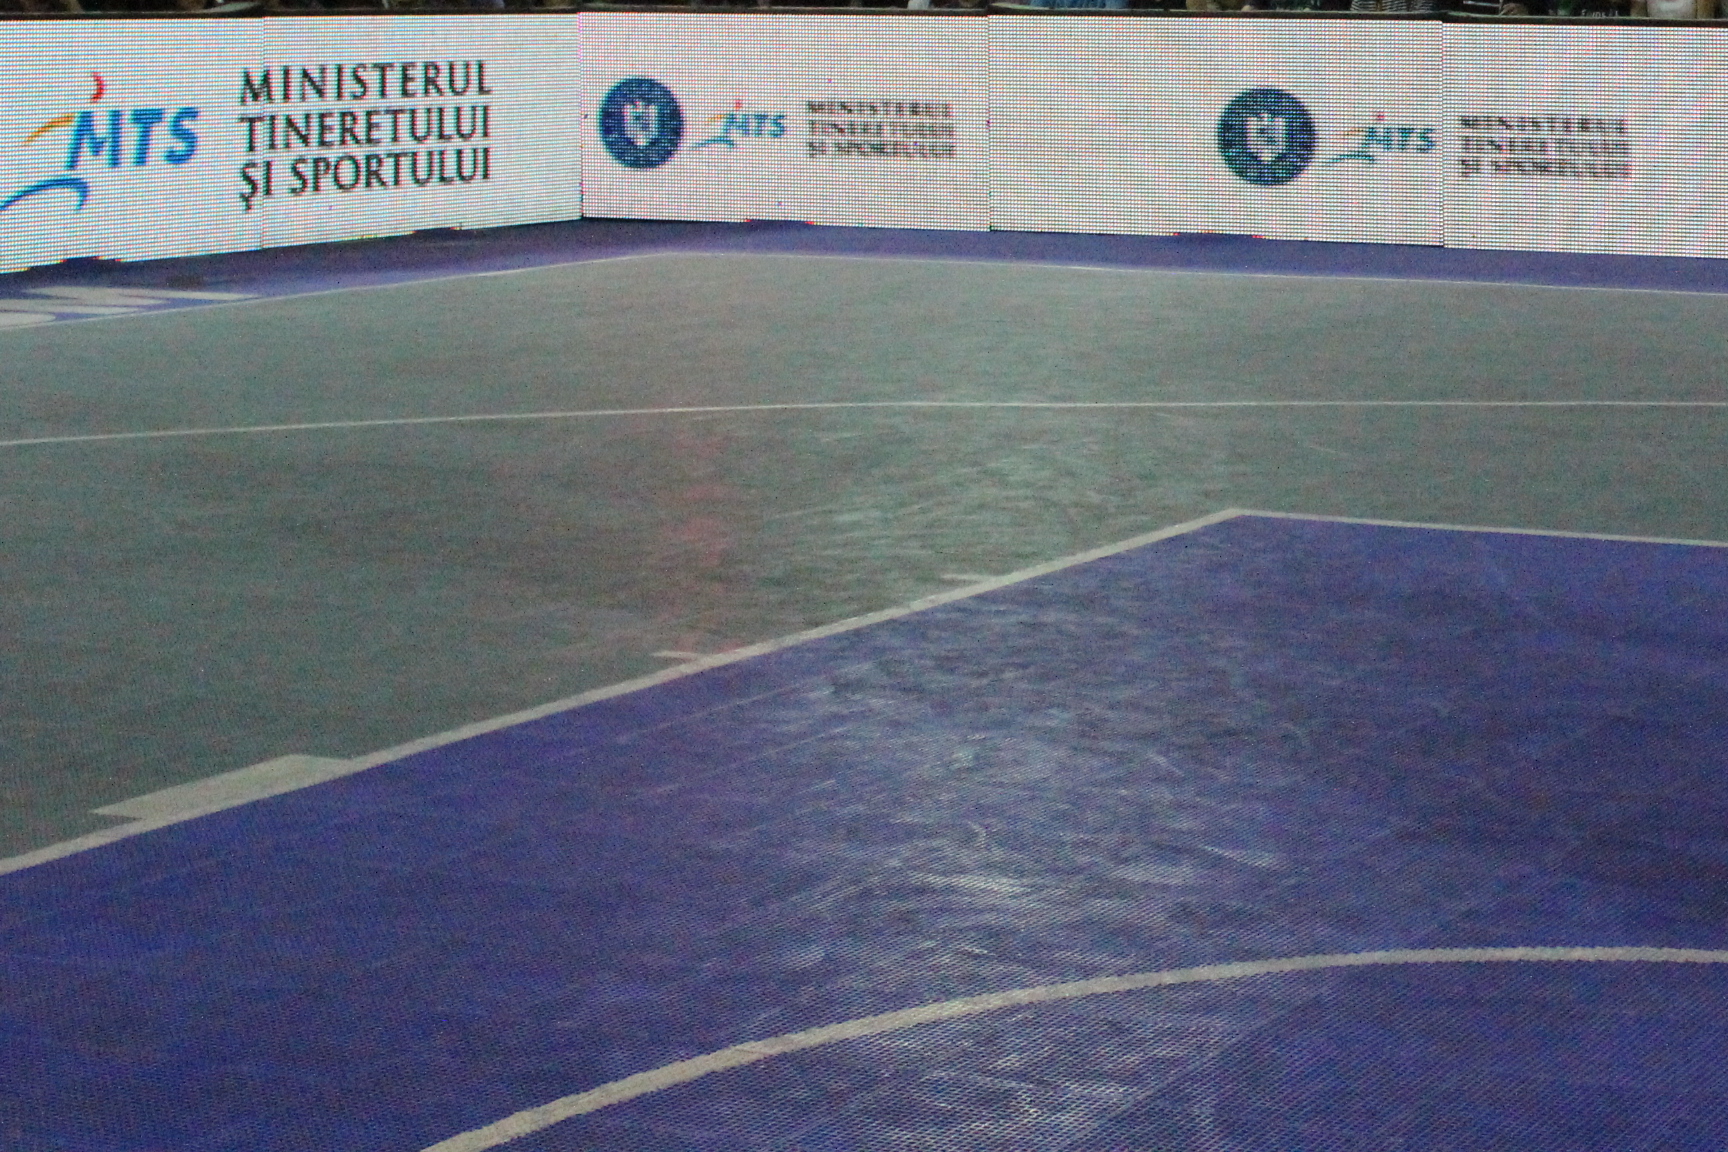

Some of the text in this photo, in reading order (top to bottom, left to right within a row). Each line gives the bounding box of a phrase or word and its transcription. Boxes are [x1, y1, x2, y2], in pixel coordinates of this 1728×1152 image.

[240, 59, 492, 106] MINISTERUL
[65, 107, 200, 170] MTS
[239, 104, 490, 152] TINERETULUI
[290, 147, 490, 197] SPORTULUI
